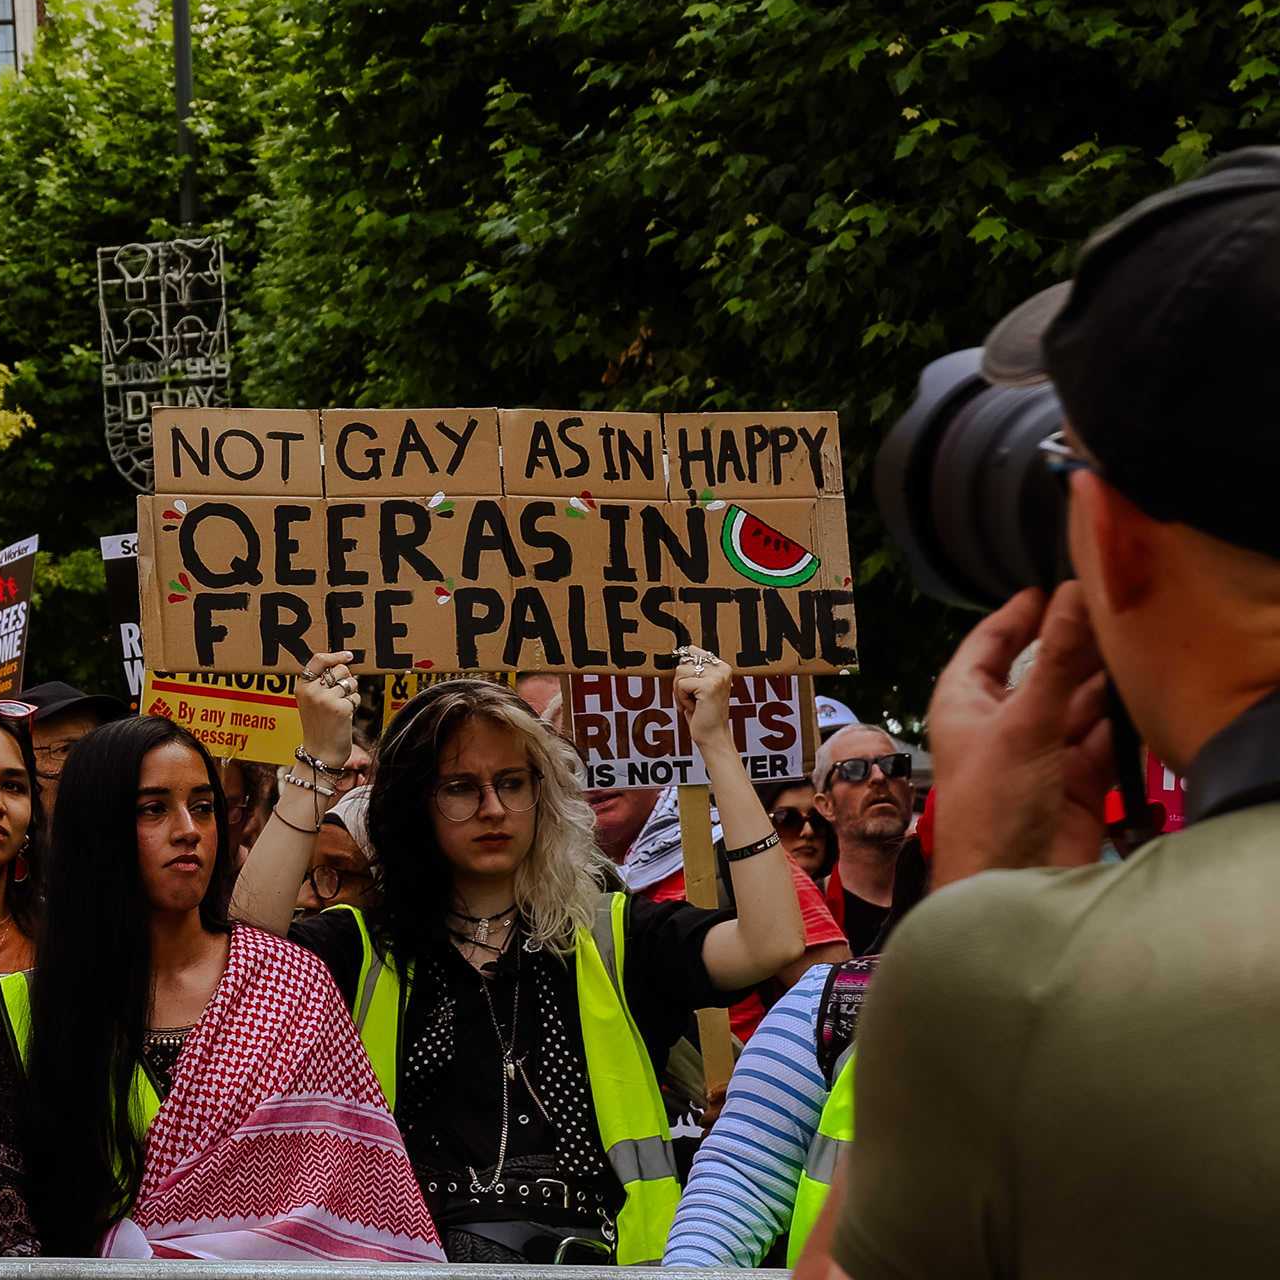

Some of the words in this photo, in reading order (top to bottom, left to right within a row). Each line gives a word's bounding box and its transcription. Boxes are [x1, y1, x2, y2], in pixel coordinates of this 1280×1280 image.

[102, 363, 117, 386] 6
[170, 357, 231, 380] 1944
[170, 424, 305, 483] NOT
[335, 416, 479, 480] GAY
[525, 417, 590, 479] AS
[598, 423, 655, 482] IN
[678, 424, 828, 489] HAPPY
[178, 500, 446, 588] QEER
[461, 500, 573, 583] AS
[599, 503, 710, 584] IN
[193, 589, 415, 669] FREE
[453, 585, 859, 671] PALESTINE
[178, 701, 196, 725] By
[200, 706, 225, 728] any
[231, 709, 276, 731] means
[587, 763, 616, 788] IS
[627, 760, 694, 786] NOT
